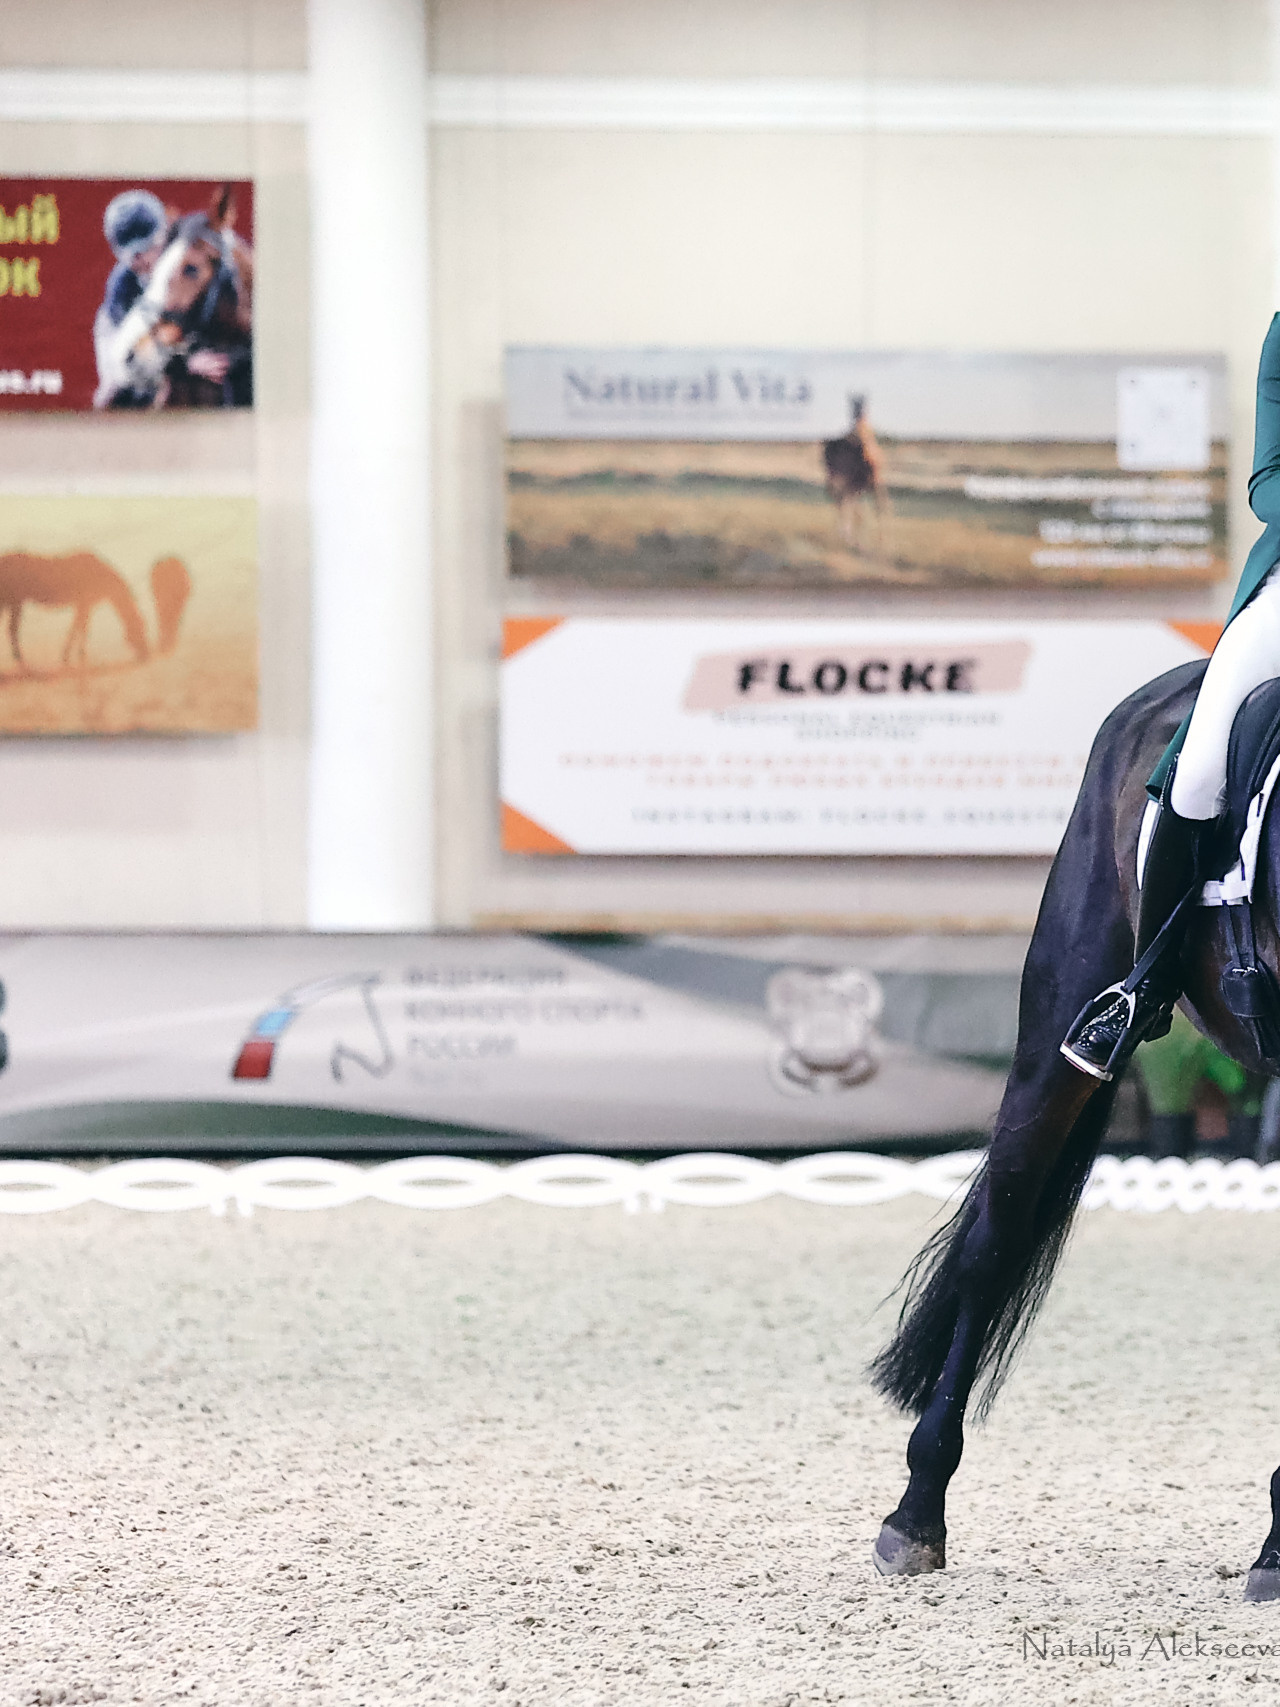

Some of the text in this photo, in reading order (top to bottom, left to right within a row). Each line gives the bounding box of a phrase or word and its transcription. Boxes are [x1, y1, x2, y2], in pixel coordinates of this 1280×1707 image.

[563, 365, 814, 404] Natural Vita
[737, 659, 979, 696] FLOCKE
